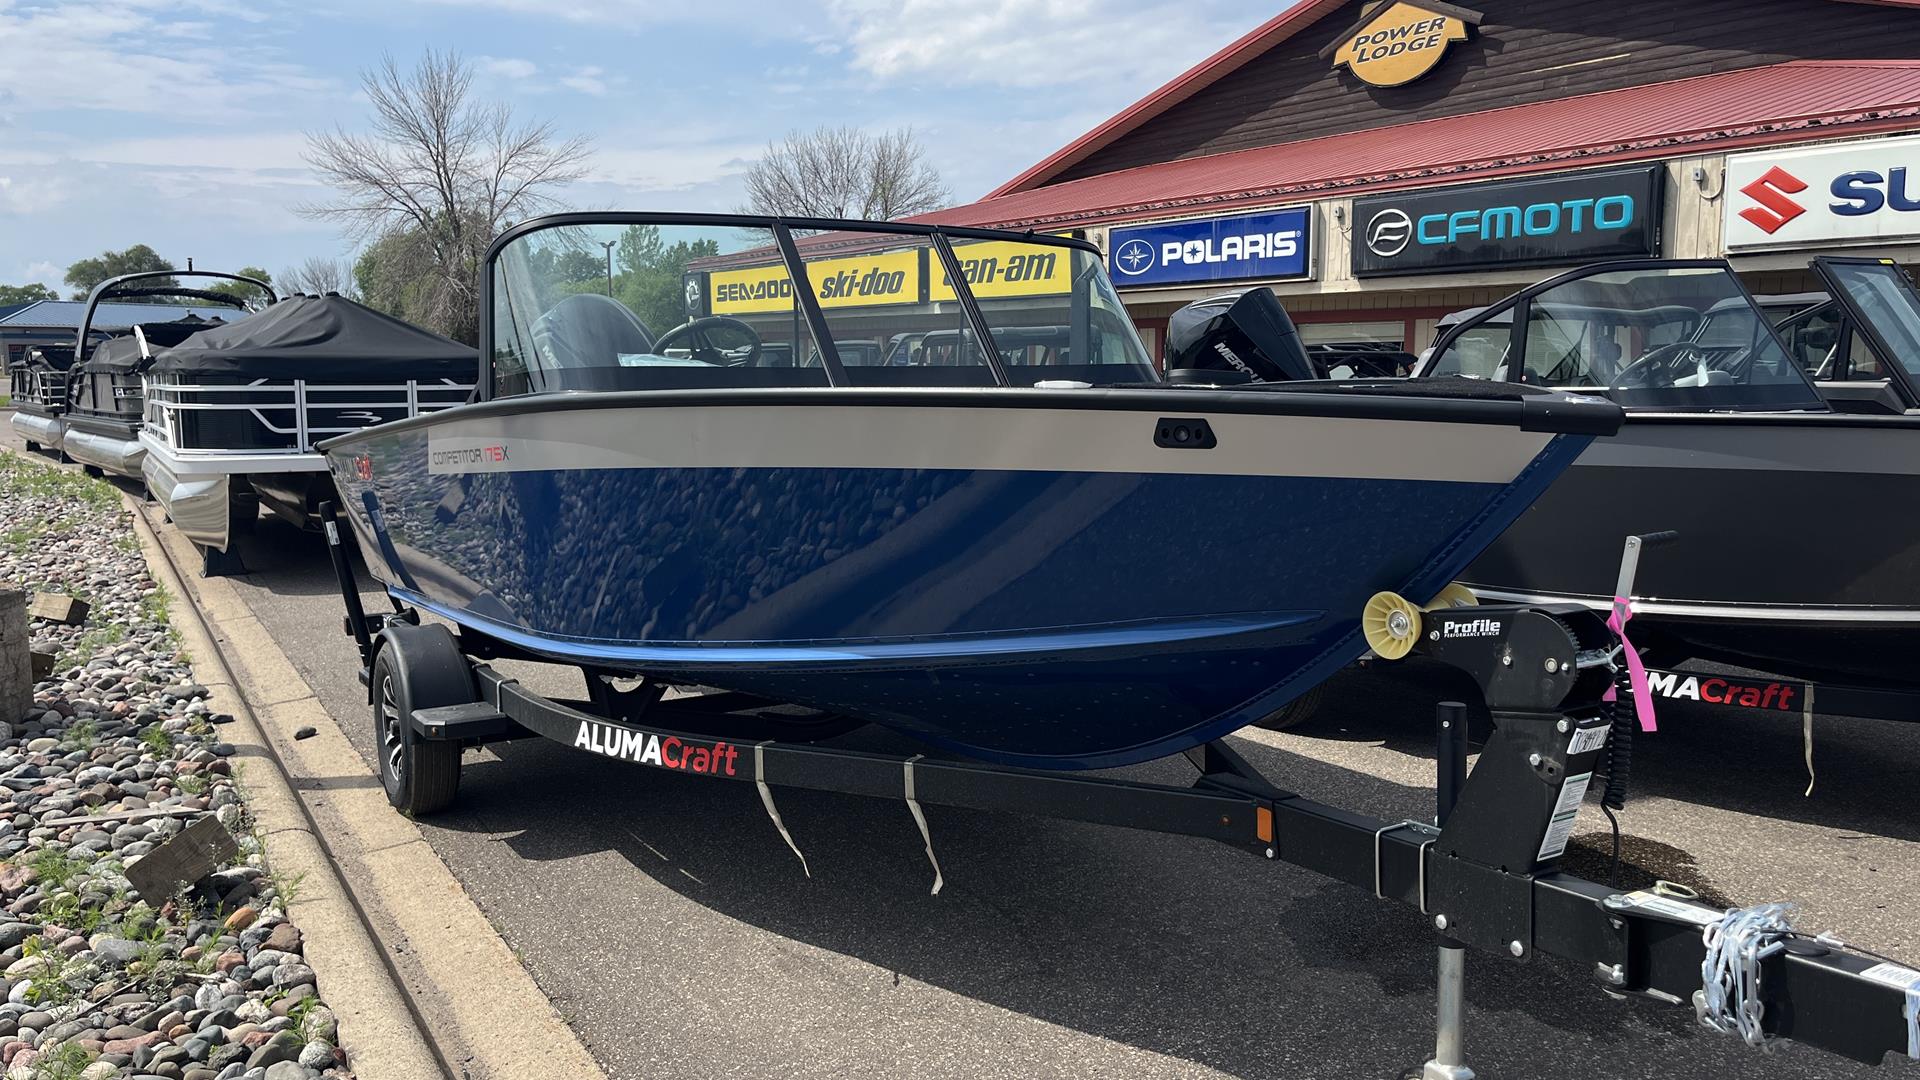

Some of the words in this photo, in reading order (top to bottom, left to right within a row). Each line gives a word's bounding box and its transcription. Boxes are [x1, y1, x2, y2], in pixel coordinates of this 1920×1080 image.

[1351, 16, 1447, 52] POWER
[1356, 33, 1442, 63] LODGE
[1417, 194, 1634, 245] CFMOTO
[820, 267, 906, 299] ski-doo
[432, 448, 482, 465] COMPETITOR
[1443, 619, 1501, 634] Profile
[573, 720, 738, 776] ALUMACraft
